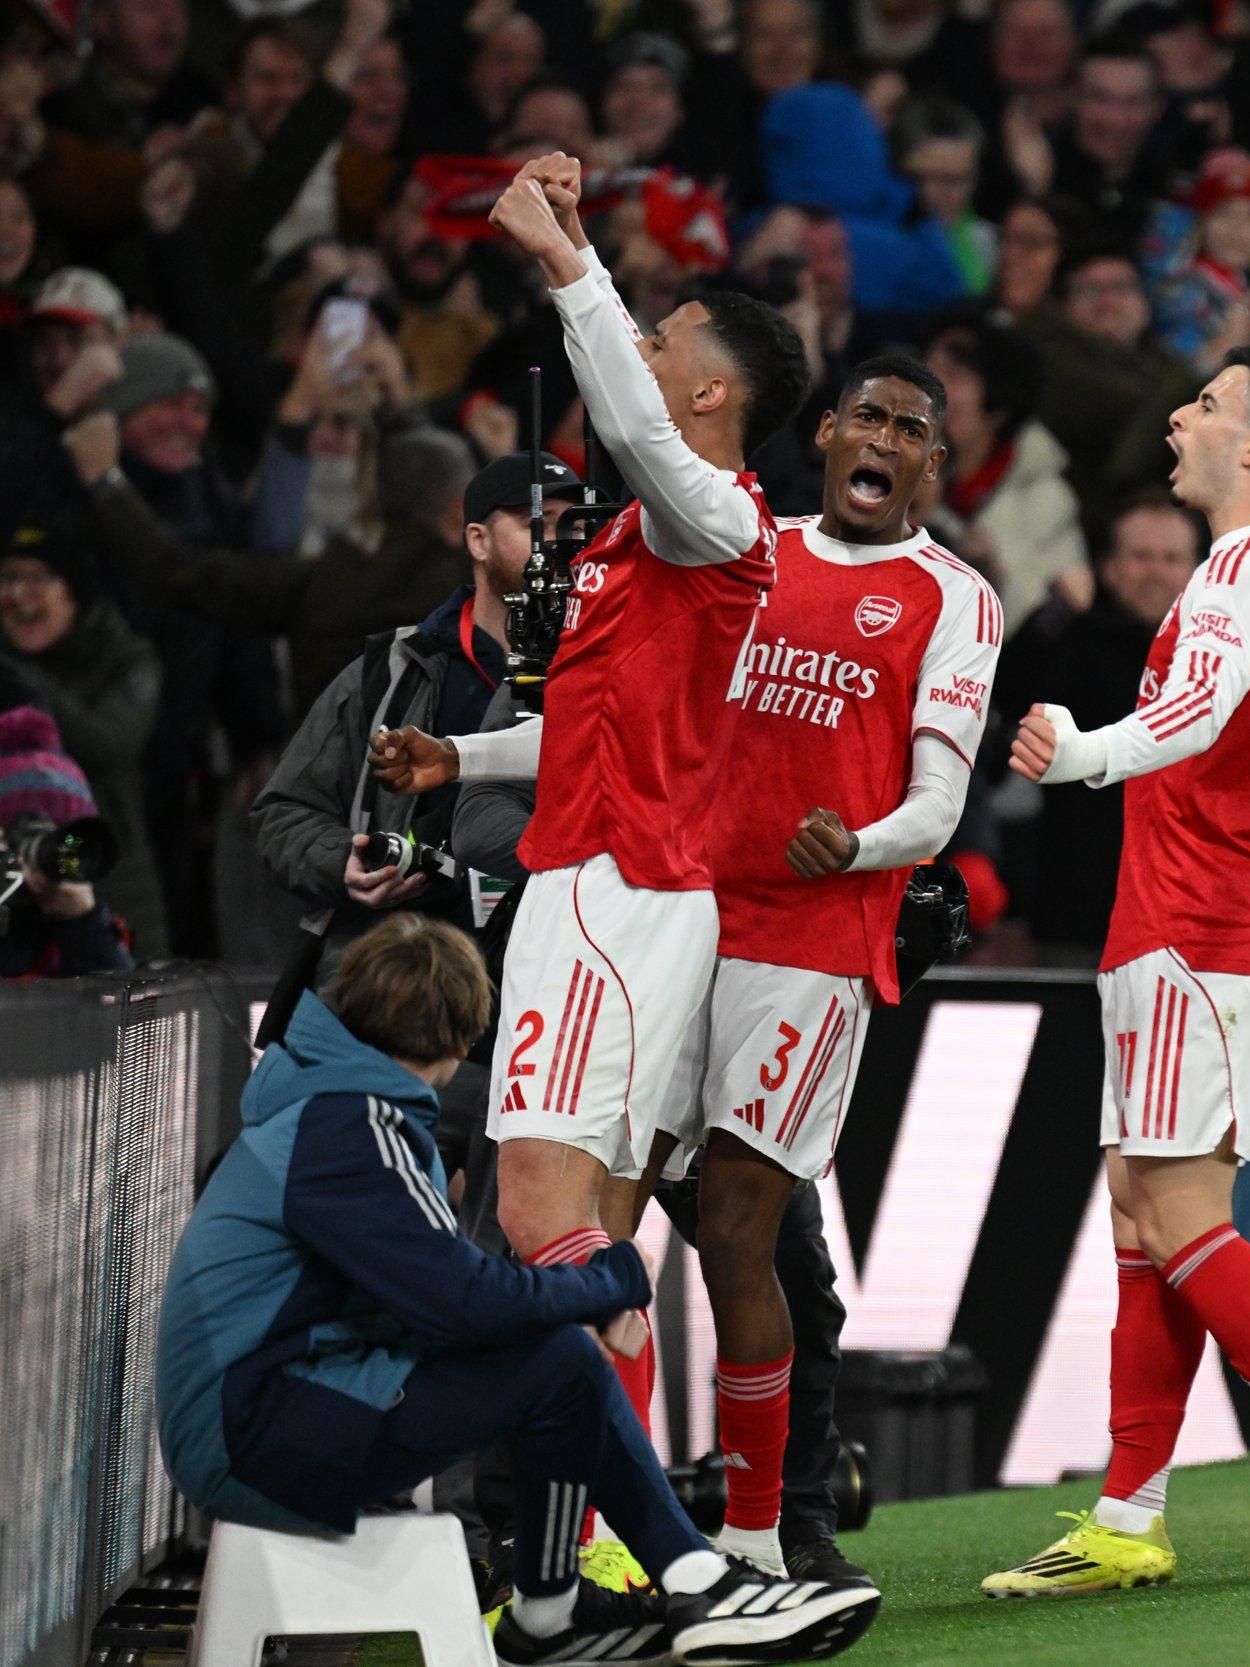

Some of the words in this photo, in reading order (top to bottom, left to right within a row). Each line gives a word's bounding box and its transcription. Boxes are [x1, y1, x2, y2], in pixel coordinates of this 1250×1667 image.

[1191, 612, 1232, 631] VISIT
[757, 682, 845, 730] BETTER
[929, 687, 982, 723] RWAN
[952, 672, 987, 699] VISIT
[508, 1010, 544, 1078] 2
[760, 1020, 802, 1092] 3
